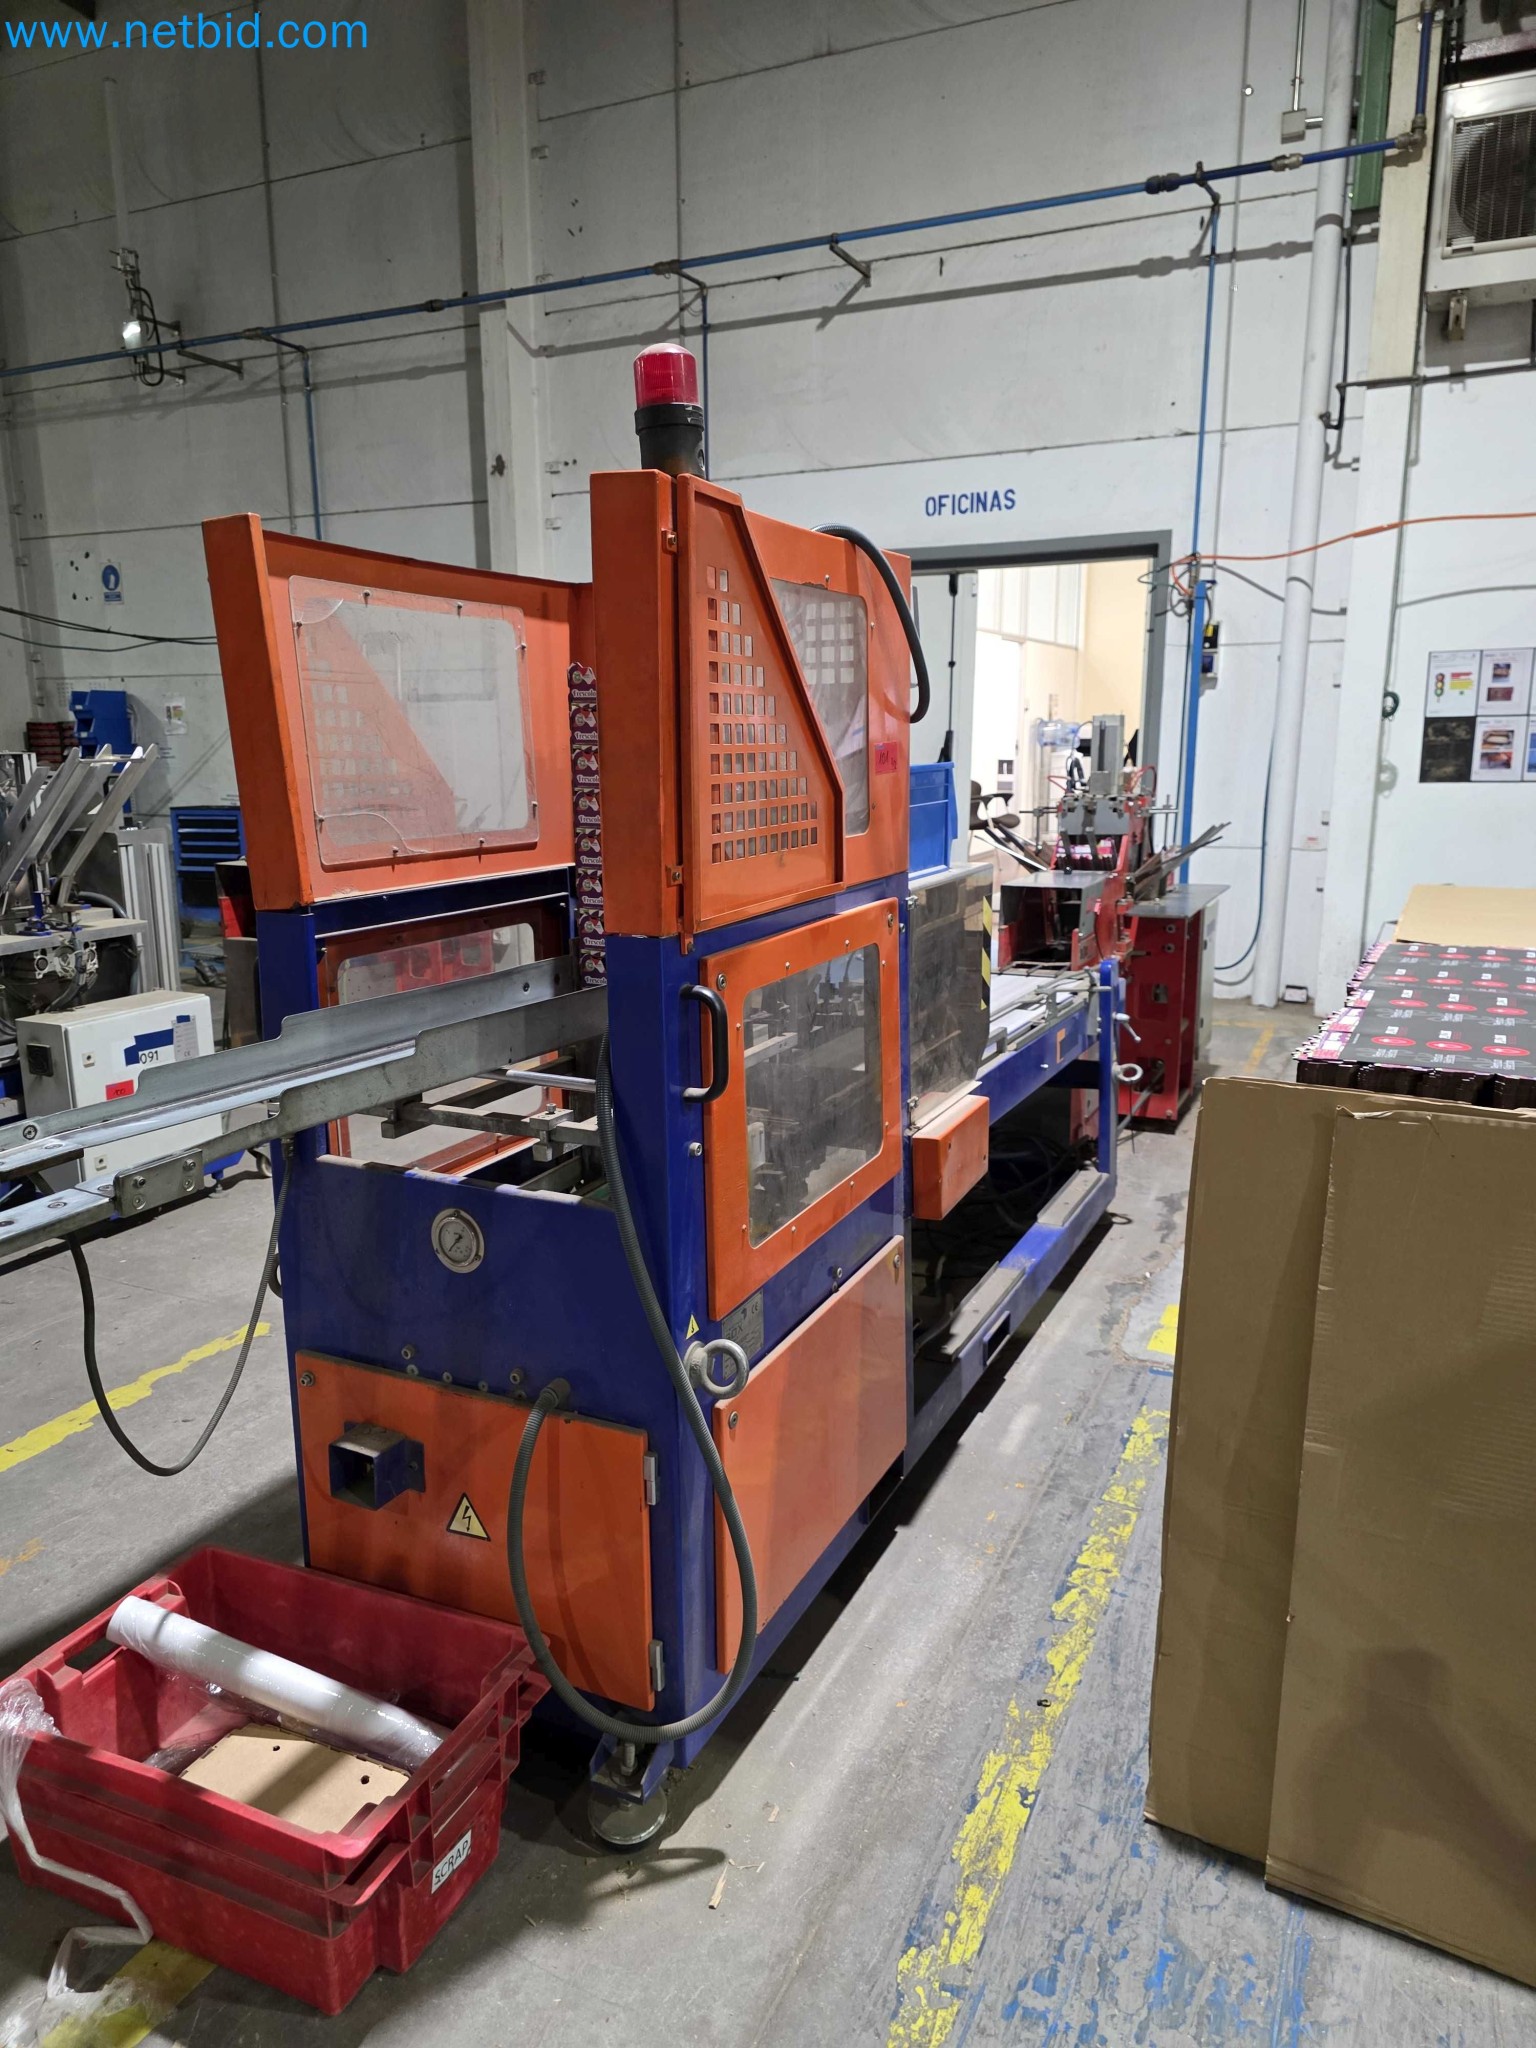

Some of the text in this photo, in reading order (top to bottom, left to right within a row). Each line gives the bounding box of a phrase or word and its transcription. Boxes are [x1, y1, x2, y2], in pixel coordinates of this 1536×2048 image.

[925, 488, 1016, 516] OFICINAS
[140, 1050, 159, 1065] 091
[434, 1840, 469, 1885] SCRAP
